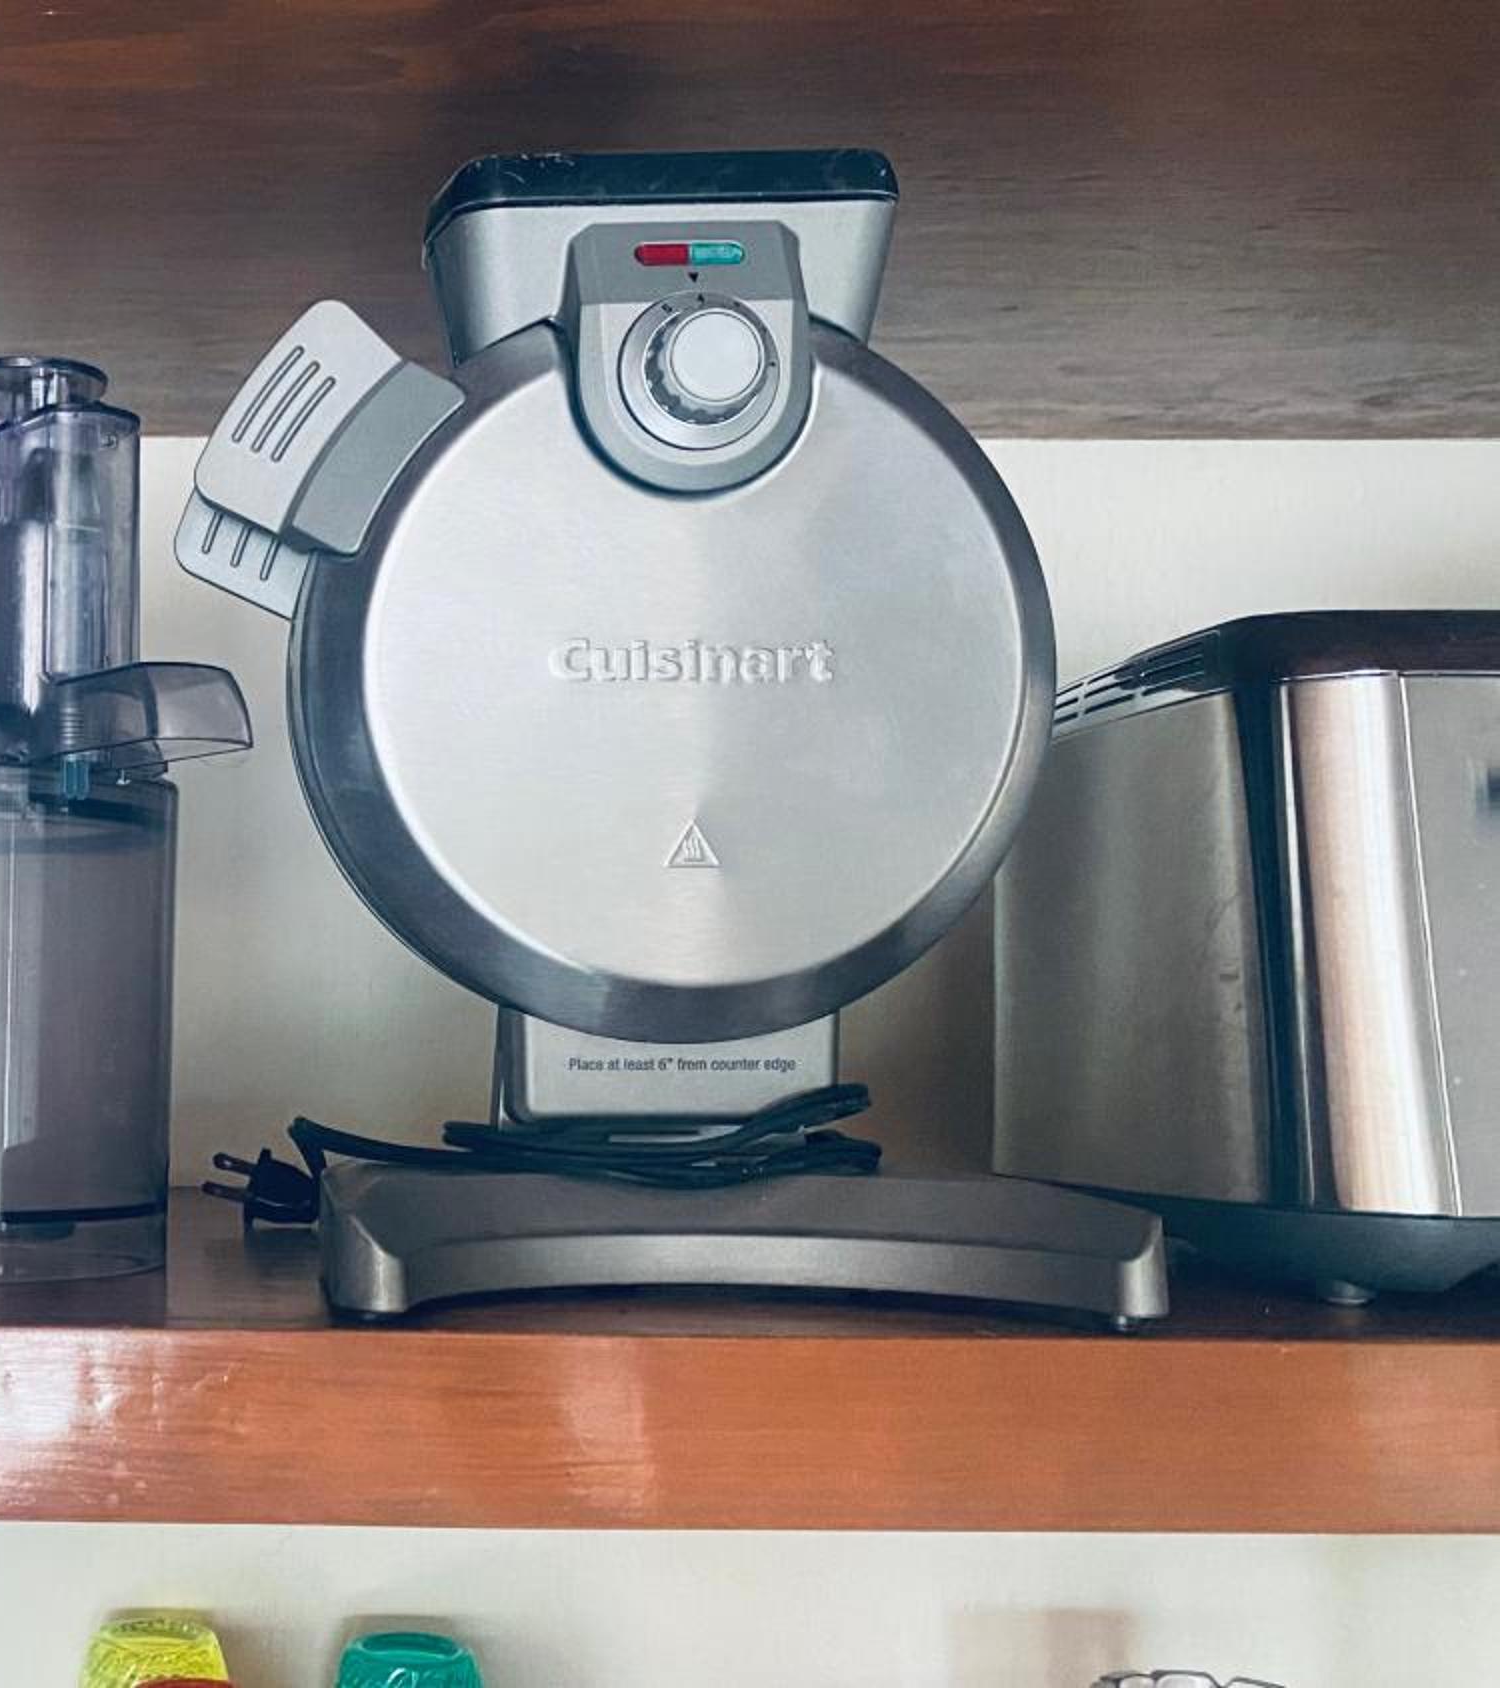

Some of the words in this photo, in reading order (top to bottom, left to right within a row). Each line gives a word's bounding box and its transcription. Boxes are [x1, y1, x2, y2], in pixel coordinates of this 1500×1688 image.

[547, 637, 835, 682] Cuisinart
[568, 1057, 603, 1071] Place
[607, 1058, 620, 1071] at
[623, 1057, 656, 1071] least
[677, 1057, 707, 1071] from
[710, 1058, 760, 1071] counter
[763, 1057, 797, 1073] edge
